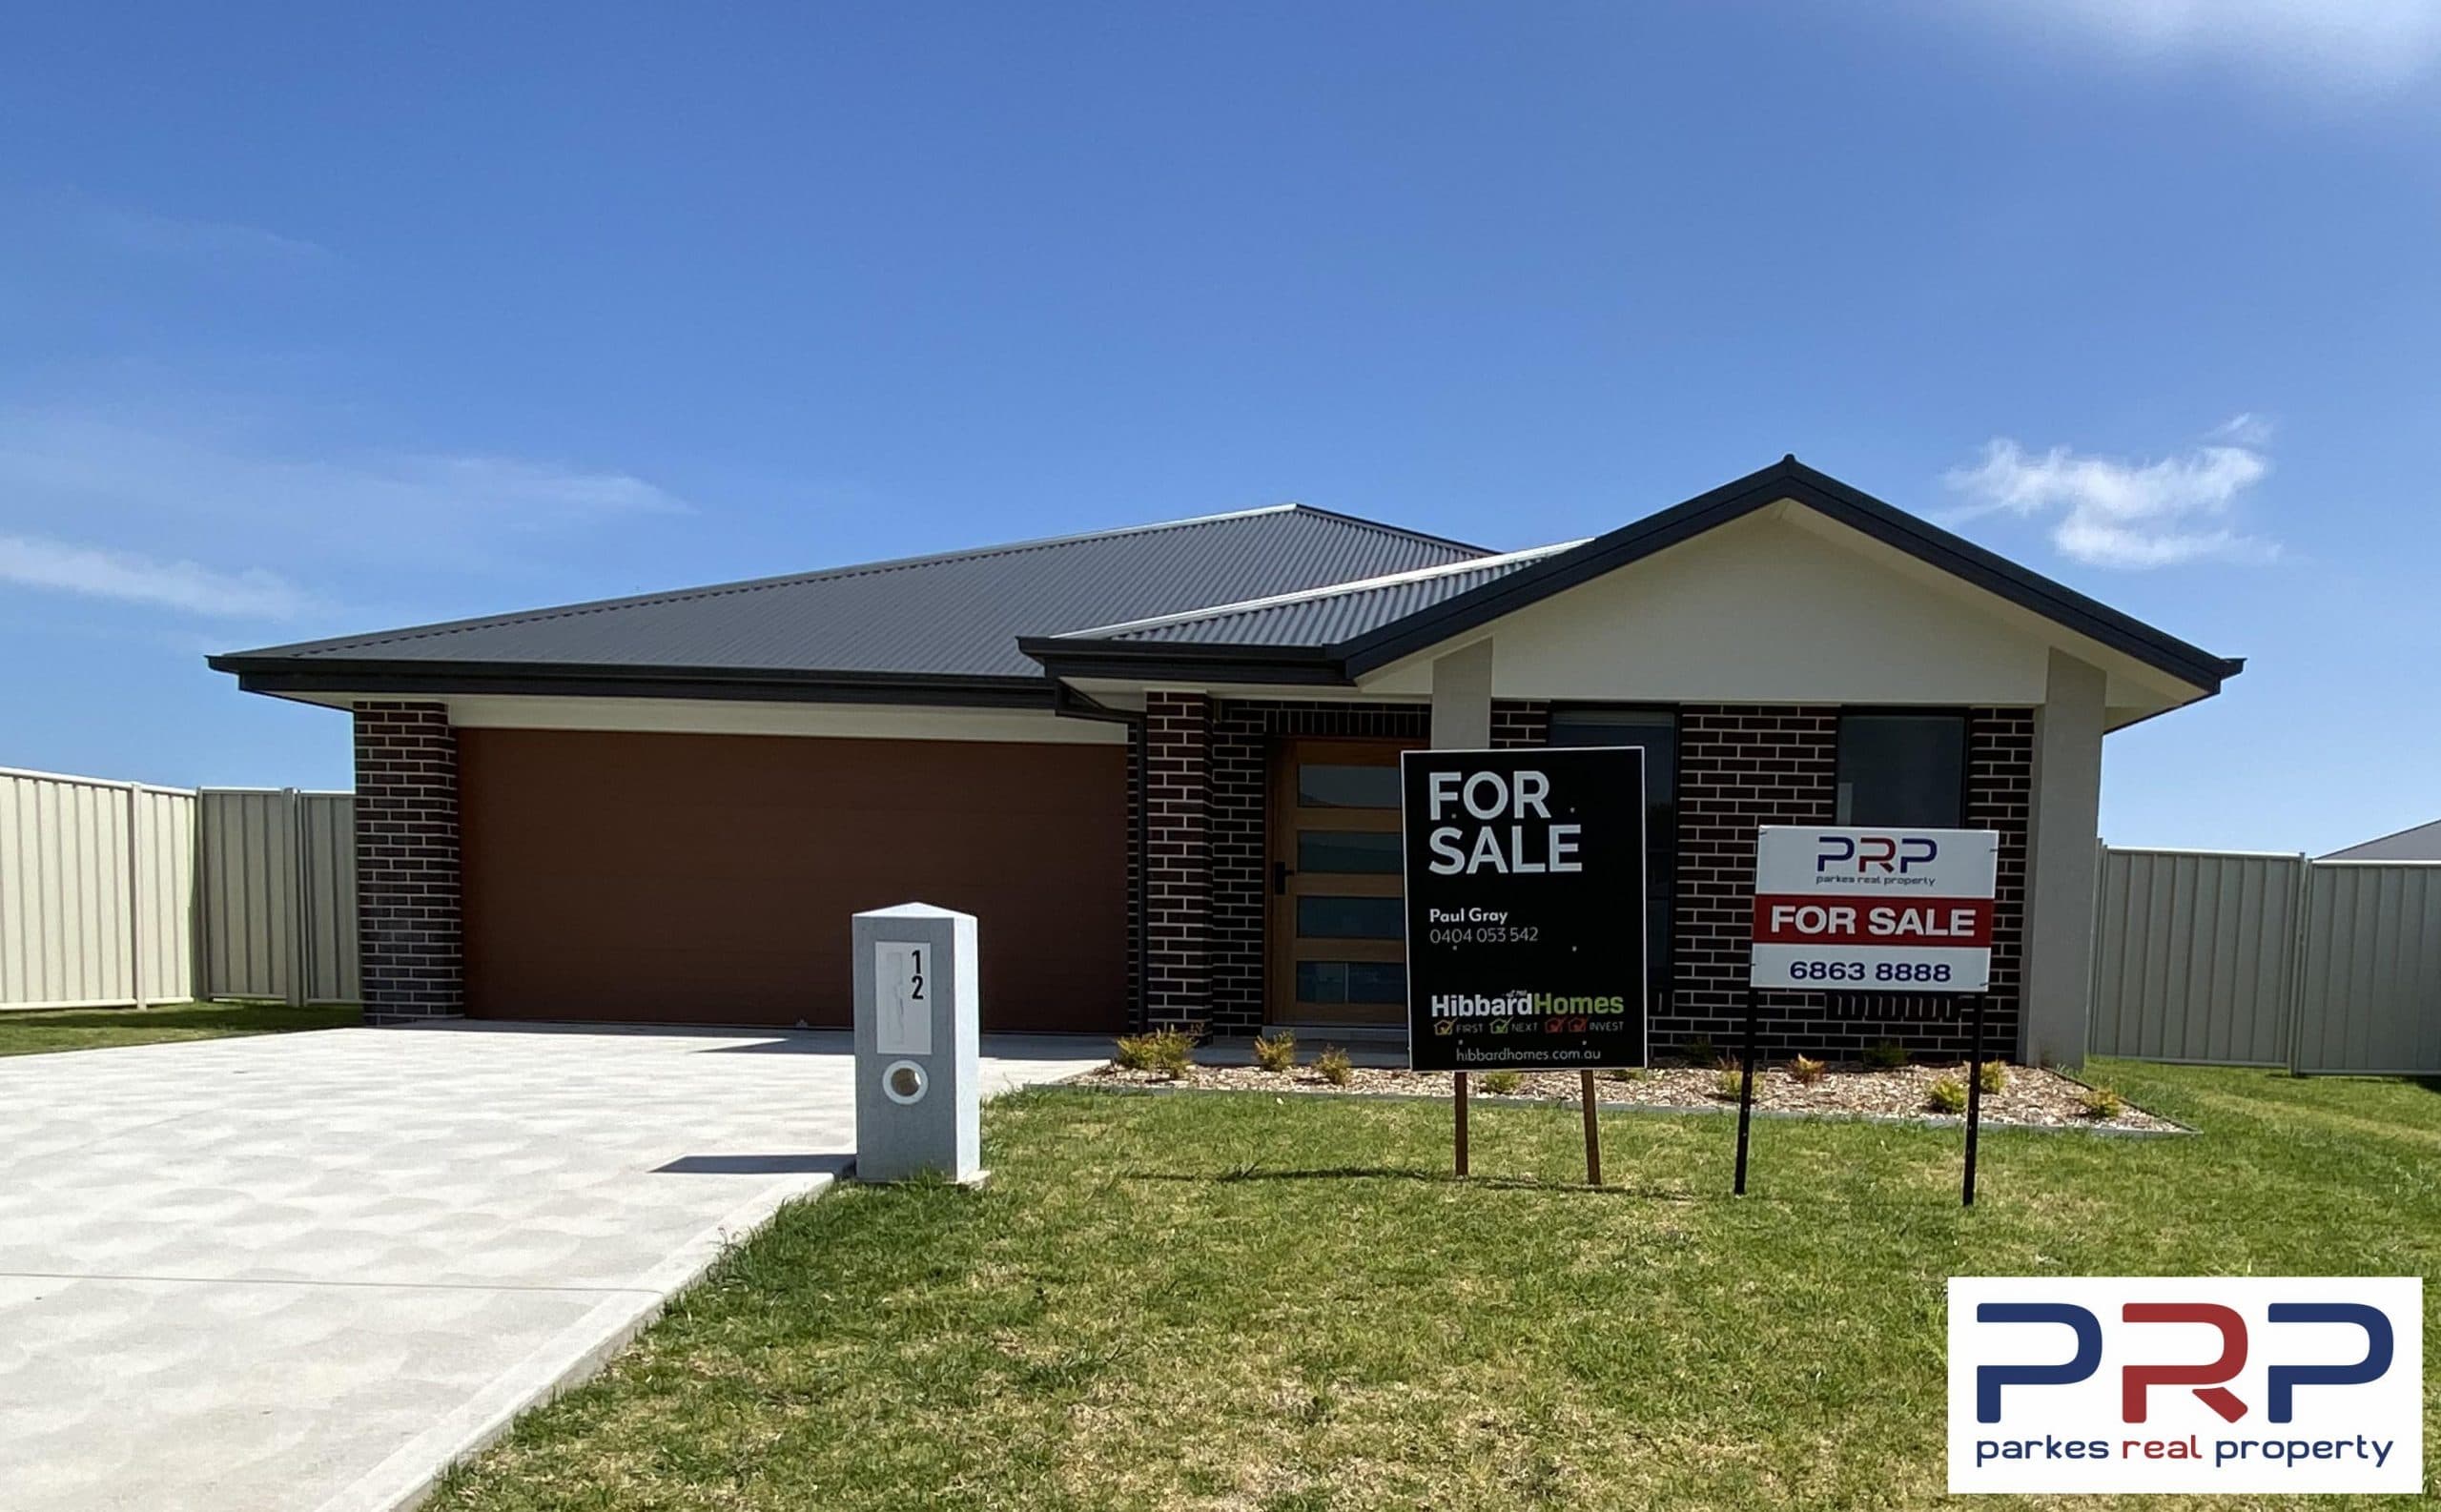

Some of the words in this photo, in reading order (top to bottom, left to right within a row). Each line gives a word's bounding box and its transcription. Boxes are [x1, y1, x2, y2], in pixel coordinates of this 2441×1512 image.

[1429, 770, 1551, 821] FOR
[1428, 824, 1583, 875] SALE
[1817, 836, 1938, 874] PRP
[1815, 874, 1855, 885] parkes
[1857, 876, 1880, 885] real
[1883, 876, 1936, 887] property
[1430, 909, 1465, 923] Paul
[1468, 908, 1508, 925] Gray
[1771, 905, 1857, 934] FOR
[1867, 907, 1977, 937] SALE
[1430, 929, 1472, 944] 0404
[1477, 928, 1507, 943] 053
[1509, 927, 1539, 942] 542
[1790, 961, 1866, 980] 6863
[1875, 963, 1951, 983] 8888
[1431, 992, 1625, 1017] HibbardHomes
[1456, 1024, 1484, 1033] FIRST
[1511, 1023, 1538, 1032] NEXT
[1590, 1021, 1625, 1032] INVEST
[1456, 1048, 1602, 1062] hibbardhomes.com.au
